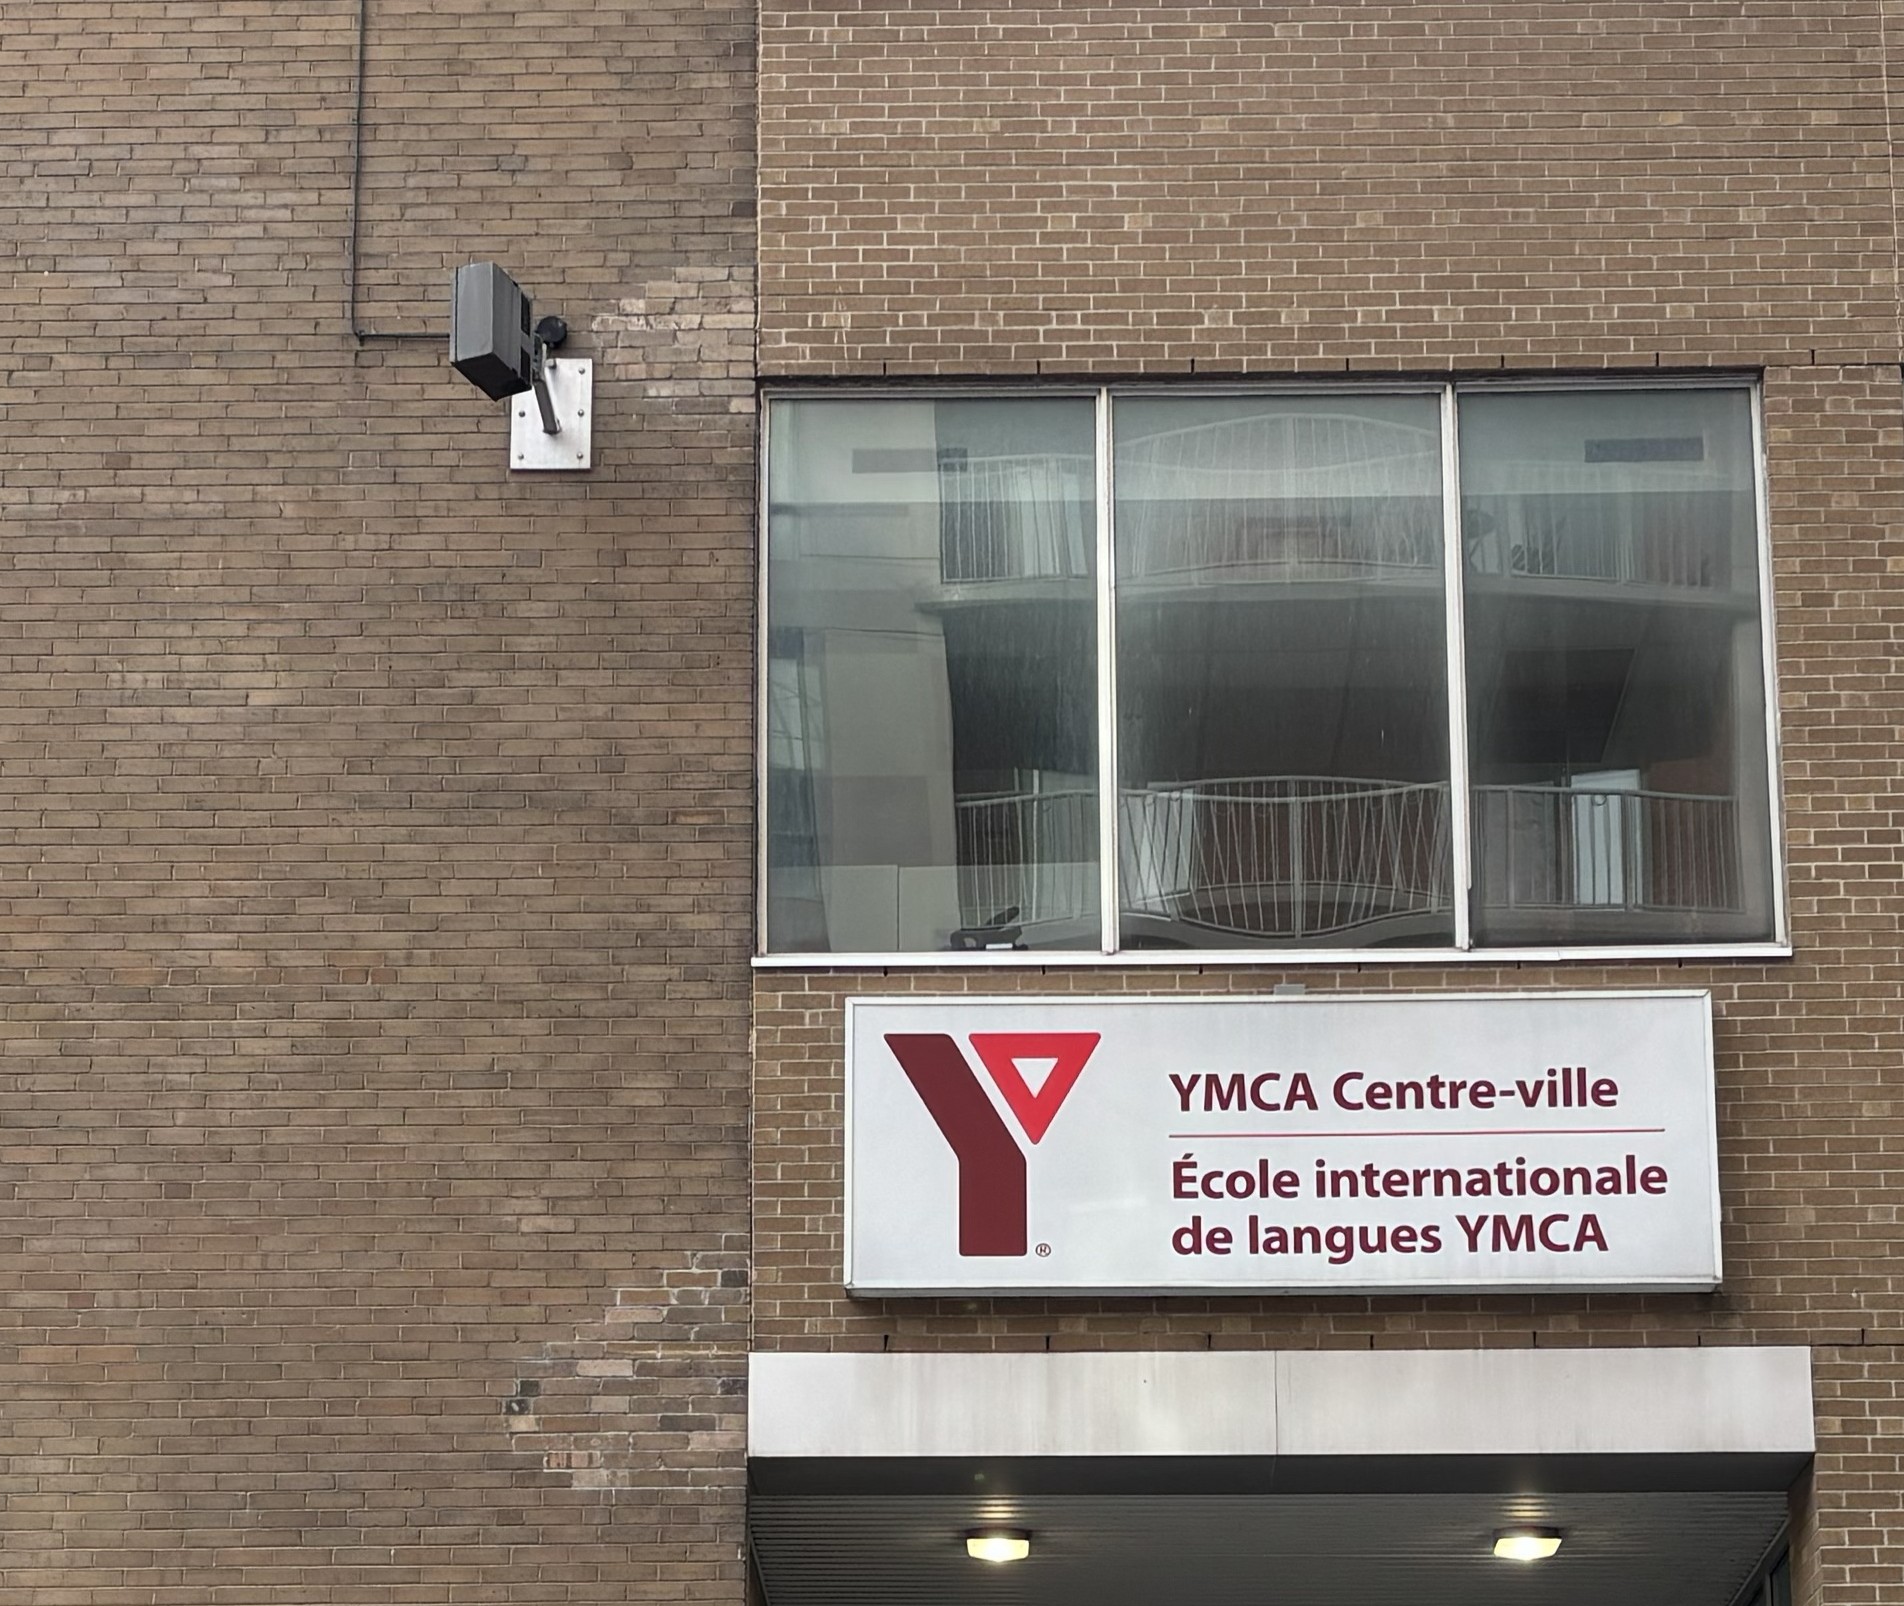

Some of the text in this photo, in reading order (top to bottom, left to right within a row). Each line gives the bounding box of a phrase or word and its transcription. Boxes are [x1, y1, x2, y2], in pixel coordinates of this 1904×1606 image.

[1169, 1067, 1619, 1113] YMCA Centre-ville
[1172, 1152, 1668, 1201] École internationale
[1172, 1213, 1609, 1264] de langues YMCA
